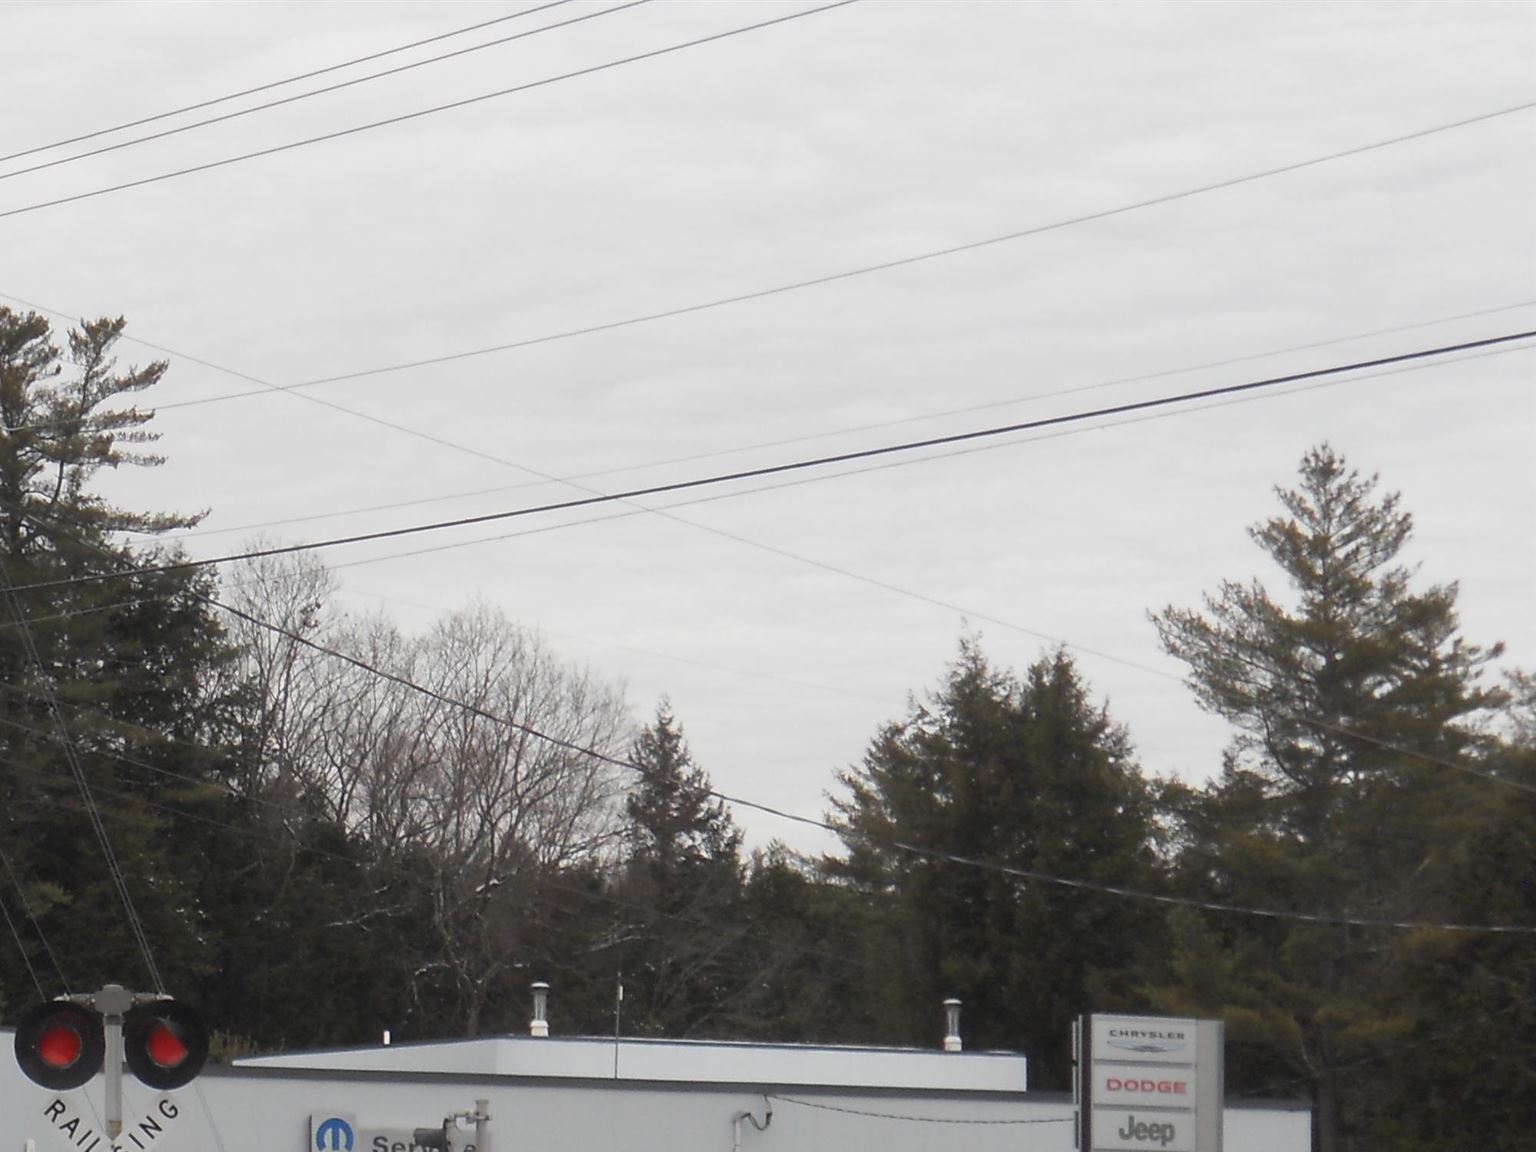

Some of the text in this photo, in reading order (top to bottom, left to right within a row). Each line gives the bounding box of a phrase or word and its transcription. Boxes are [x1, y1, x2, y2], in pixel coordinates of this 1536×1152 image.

[1109, 1029, 1185, 1040] CHRYSLER
[1106, 1078, 1187, 1094] DODGE
[1119, 1115, 1176, 1147] Jeep
